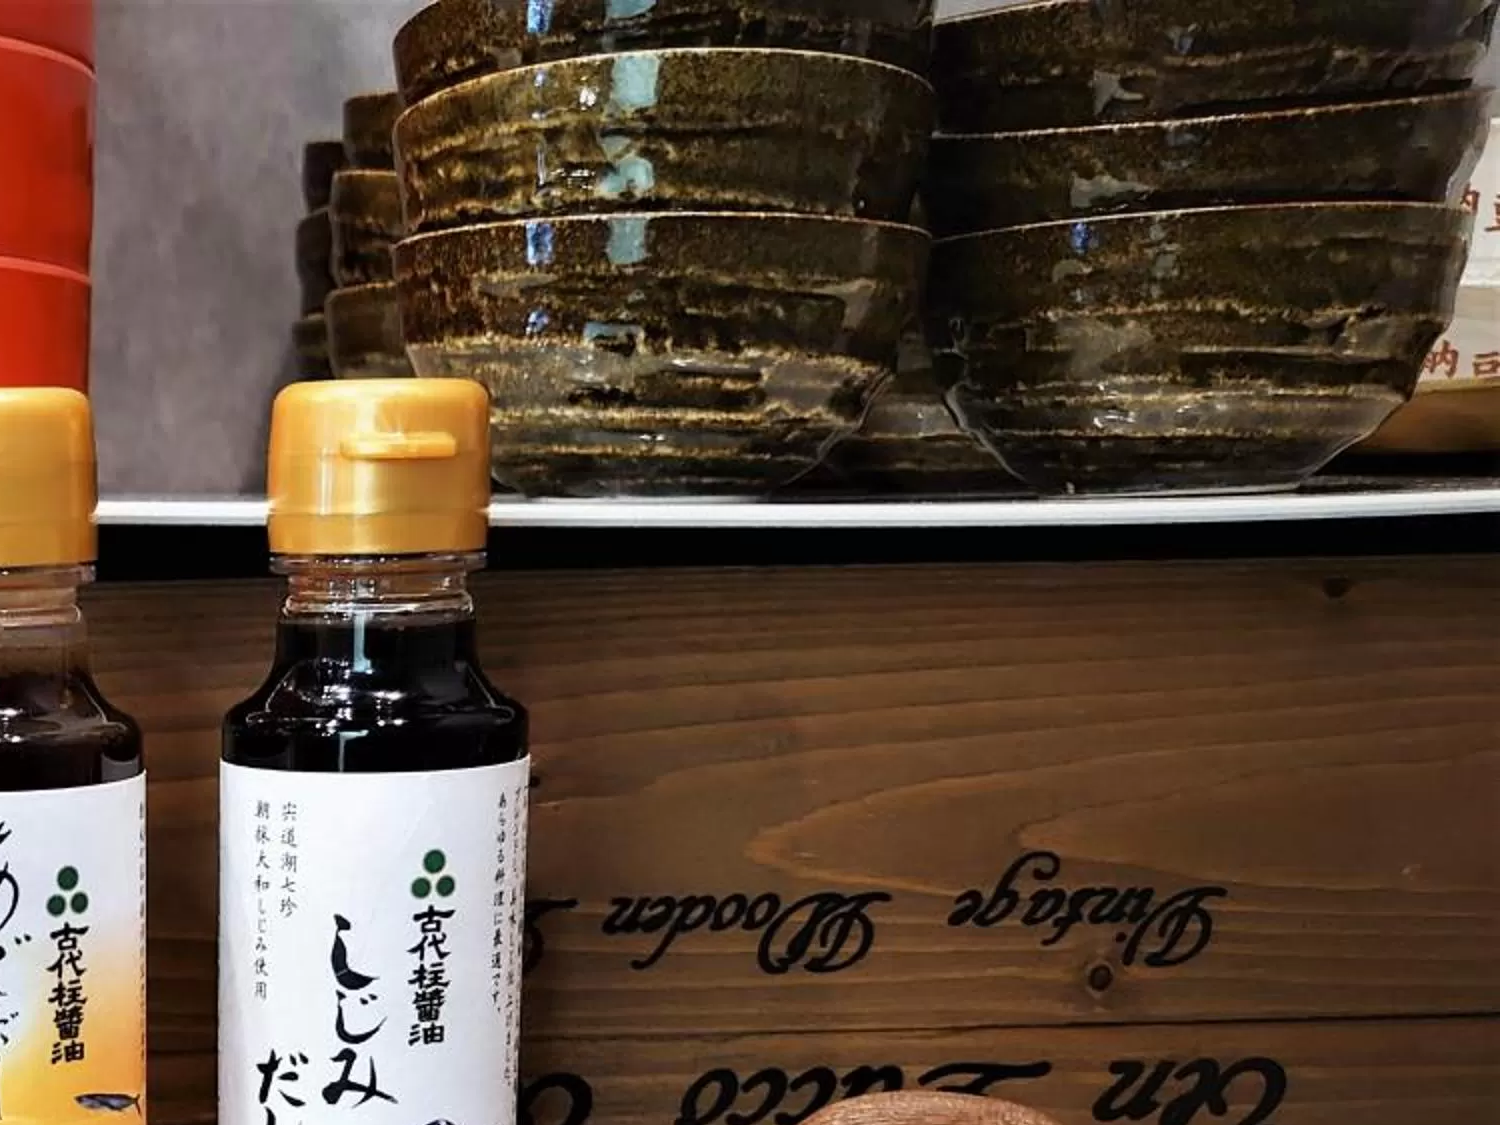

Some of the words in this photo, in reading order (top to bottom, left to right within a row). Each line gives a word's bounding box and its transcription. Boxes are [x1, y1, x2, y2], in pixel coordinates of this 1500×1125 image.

[601, 890, 892, 975] Wooden
[947, 850, 1229, 968] Vintage
[321, 913, 398, 1109] しじみ
